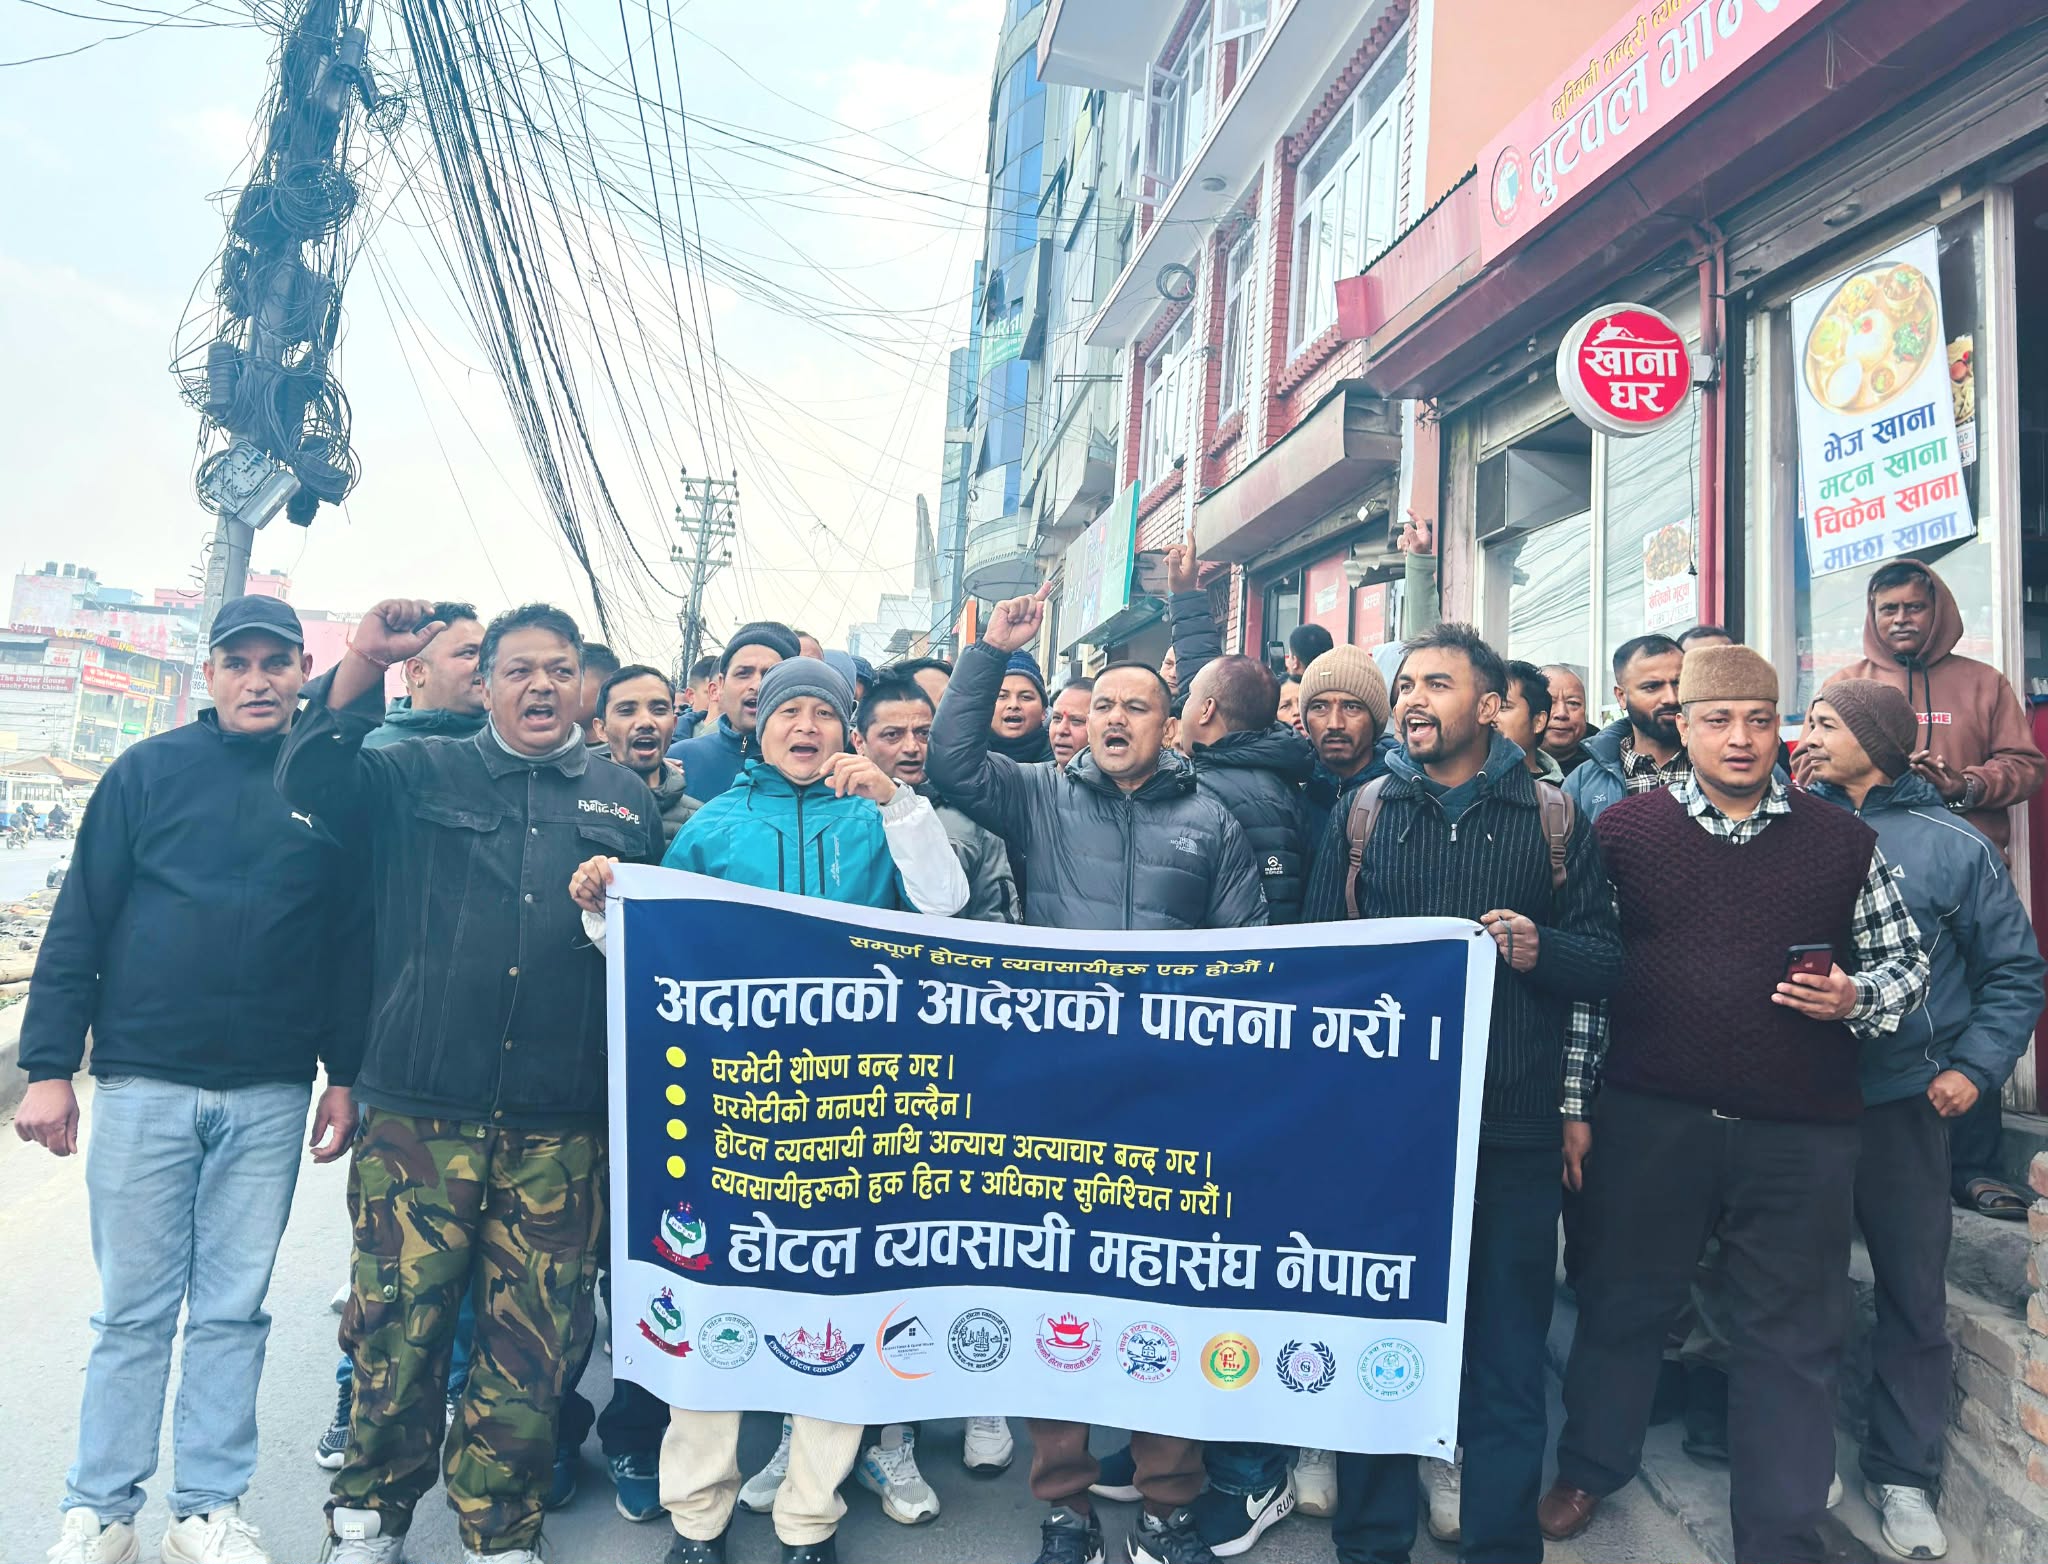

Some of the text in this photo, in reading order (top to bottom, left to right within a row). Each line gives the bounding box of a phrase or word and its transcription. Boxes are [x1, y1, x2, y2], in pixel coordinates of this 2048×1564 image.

[1528, 51, 1648, 207] बुटवल
[1584, 346, 1679, 376] खाना
[1608, 382, 1664, 412] घर
[1824, 402, 1936, 463] भेज खाना
[1818, 462, 1874, 500] मटन
[1882, 436, 1948, 478] खाना
[1814, 472, 1959, 538] चिकेन खाना
[1824, 512, 1957, 571] माछा खाना
[849, 936, 922, 958] सम्पूर्ण
[930, 947, 994, 969] होटल
[1156, 964, 1198, 976] एक
[654, 964, 904, 1032] अदालतको
[918, 980, 1124, 1035] आदेशको
[1140, 993, 1296, 1050] पालना
[712, 1050, 784, 1084] घरभेटी
[790, 1048, 852, 1084] शोषण
[858, 1054, 902, 1081] बन्द
[712, 1090, 810, 1124] घरभेटीको
[816, 1084, 888, 1120] मनपरी
[714, 1122, 769, 1161] होटल
[774, 1126, 866, 1162] व्यवसायी
[872, 1122, 922, 1156] माथि
[930, 1130, 1006, 1156] अन्याय
[1013, 1134, 1106, 1164] अत्याचार
[1114, 1144, 1158, 1176] बन्द
[868, 1171, 906, 1204] हक
[912, 1162, 952, 1200] हित
[960, 1170, 974, 1194] र
[981, 1165, 1066, 1200] अधिकार
[1073, 1172, 1172, 1213] सुनिश्चित
[728, 1211, 1416, 1302] होटल व्यवसायी महासंघ नेपाल
[1277, 1490, 1294, 1516] RUN
